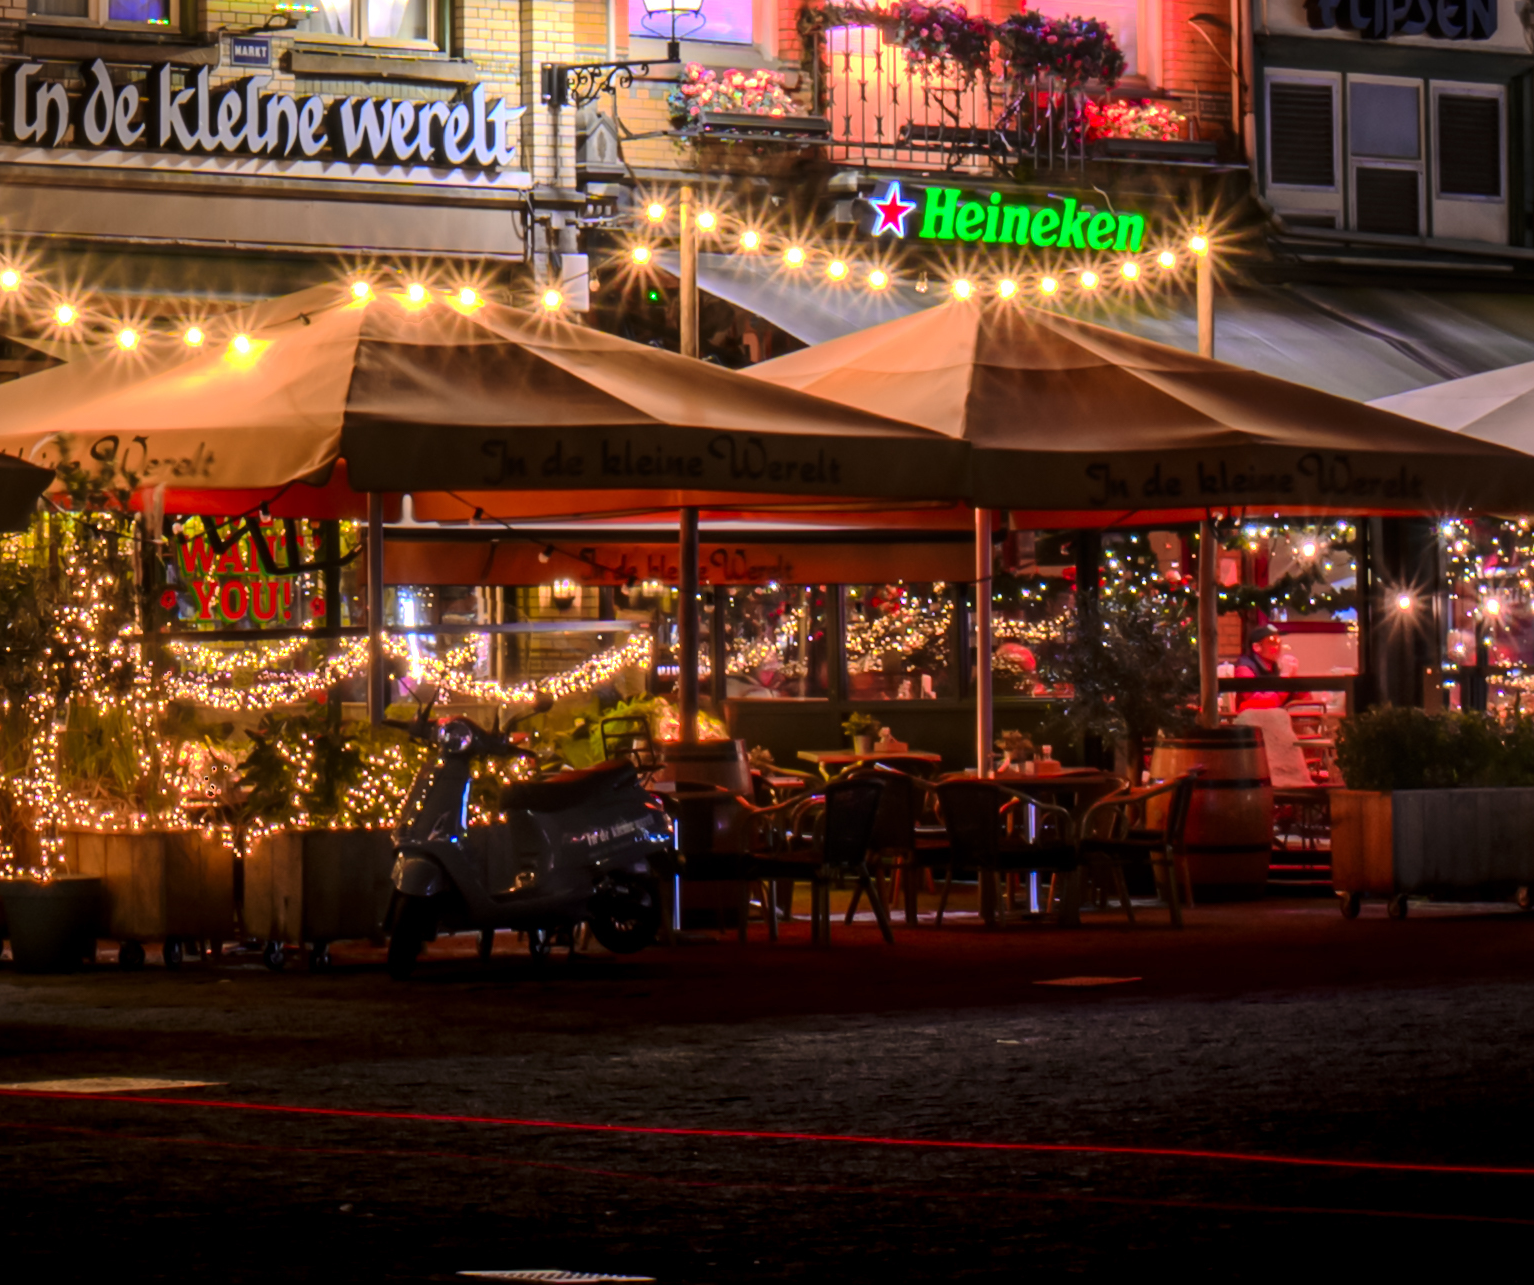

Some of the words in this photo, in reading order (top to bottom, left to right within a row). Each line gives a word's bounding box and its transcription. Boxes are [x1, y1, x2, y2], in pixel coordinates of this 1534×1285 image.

[235, 45, 267, 59] MARKT
[84, 58, 146, 146] de
[340, 82, 528, 166] werelt
[918, 187, 1145, 253] Heineken
[646, 552, 708, 580] klee
[192, 580, 293, 622] YOU!
